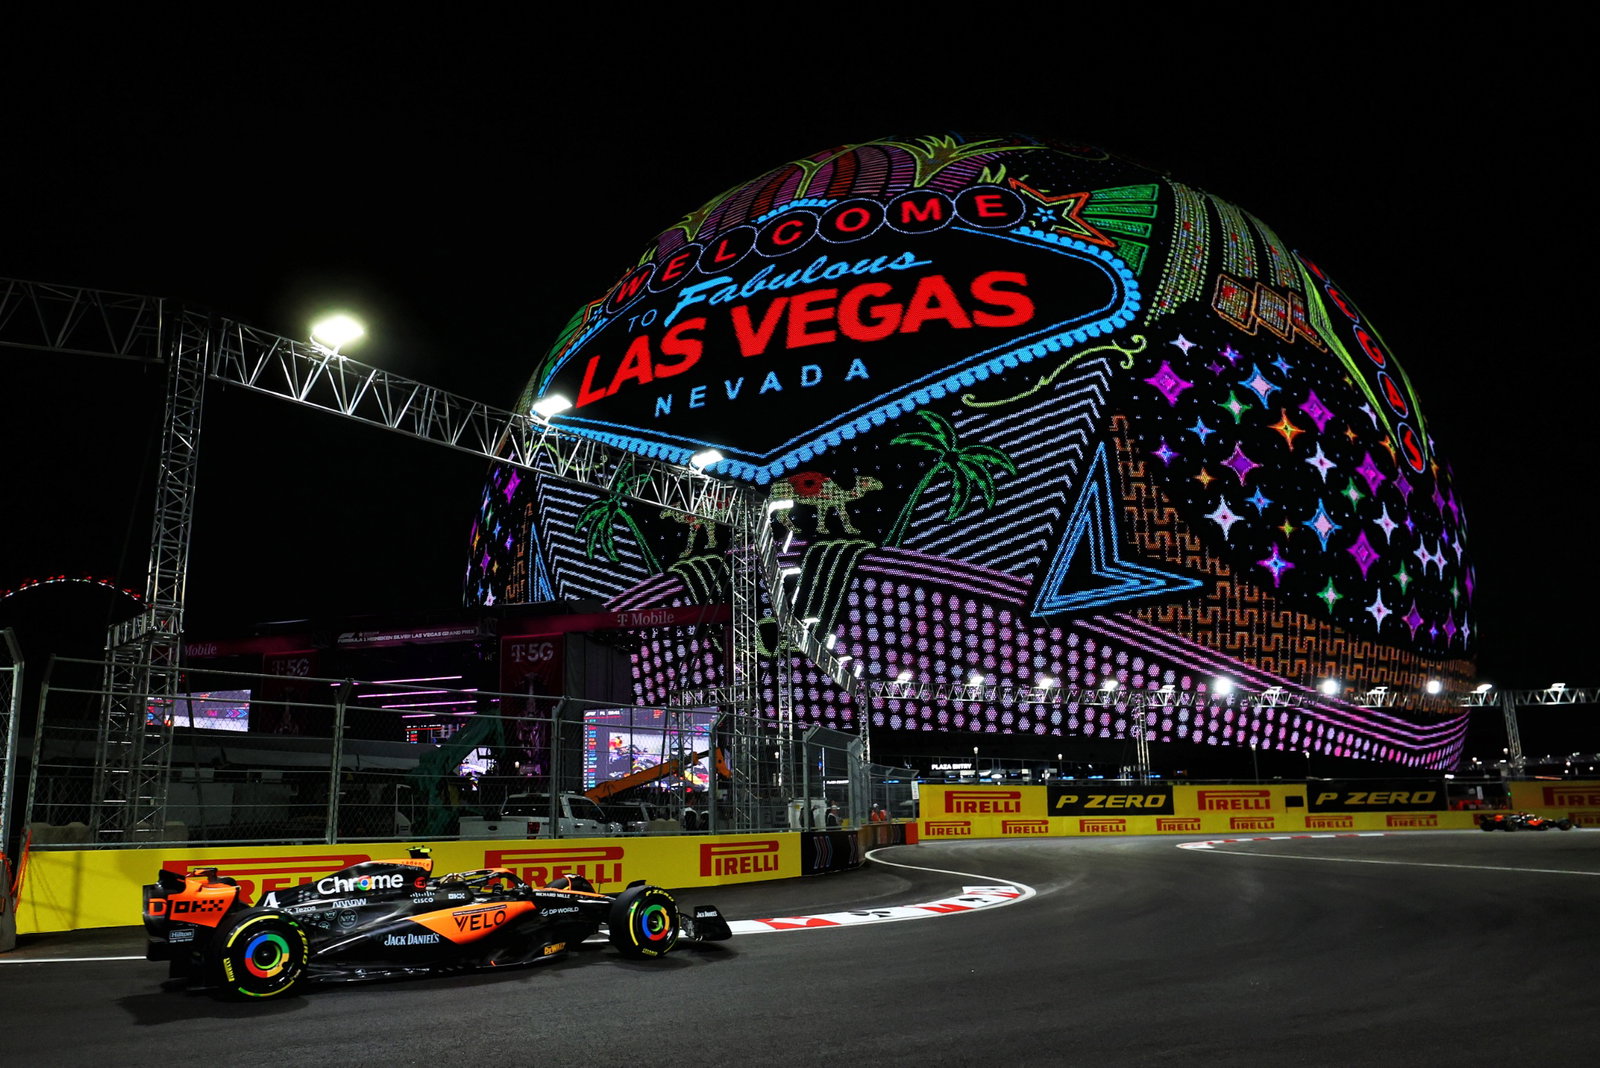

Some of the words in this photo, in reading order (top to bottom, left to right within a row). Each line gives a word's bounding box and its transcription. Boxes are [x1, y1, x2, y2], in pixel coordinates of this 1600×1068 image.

[616, 194, 1008, 304] WELCOME
[628, 309, 657, 333] TO
[664, 251, 932, 327] Fabulous
[575, 317, 707, 408] LAS
[730, 271, 1036, 358] VEGAS
[655, 358, 869, 418] NEVADA
[631, 611, 675, 625] Mobile
[527, 642, 555, 662] 5G
[286, 658, 311, 677] 5G
[944, 790, 1021, 813] PIRELLI
[1056, 795, 1079, 808] P
[1084, 795, 1166, 808] ZERO
[1197, 790, 1271, 811] PIRELLI
[1315, 792, 1338, 805] P
[1344, 791, 1436, 804] ZERO
[1002, 819, 1049, 834] PIRELLI
[1079, 818, 1126, 833] PIRELLI
[1156, 818, 1201, 831] PIRELLI
[1230, 816, 1274, 830] PIRELLI
[1305, 815, 1353, 828] PIRELLI
[1386, 814, 1438, 827] PIRELLI
[925, 821, 971, 836] PIRELLI
[699, 840, 780, 877] PIRELLI
[317, 873, 404, 895] Chrome
[174, 900, 224, 913] OKX
[263, 892, 281, 908] 4
[294, 906, 317, 914] Tezos
[454, 910, 507, 932] VELO
[384, 934, 406, 946] JACK
